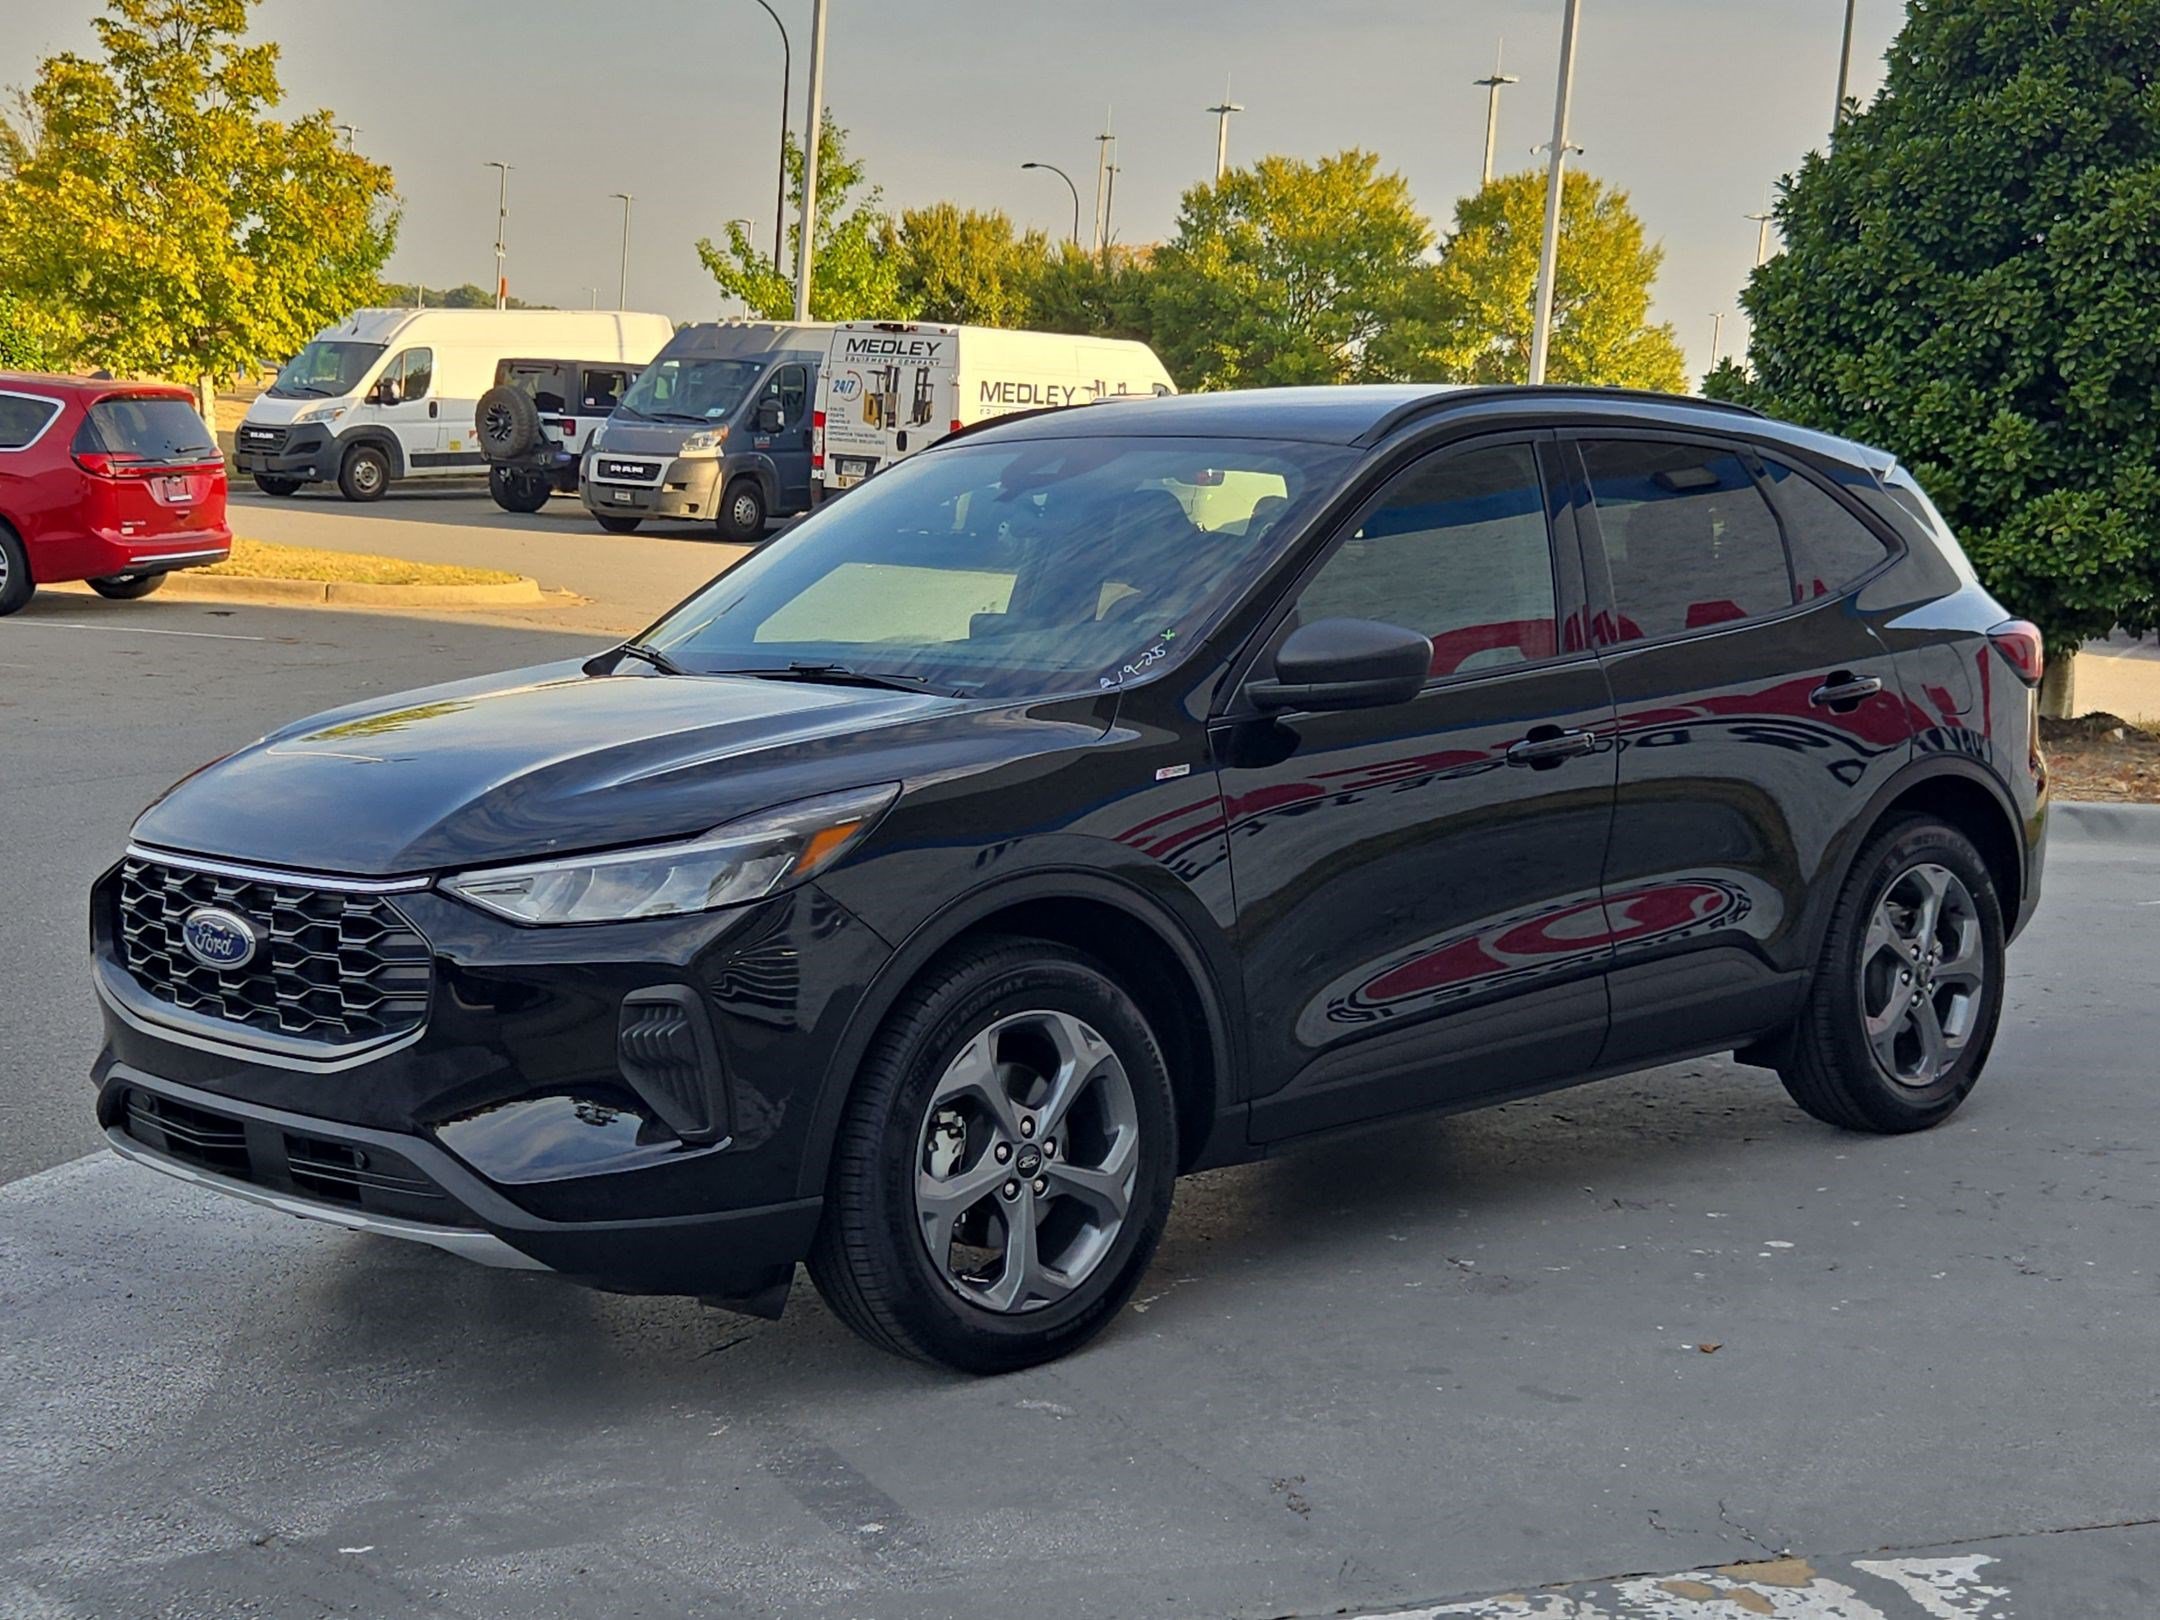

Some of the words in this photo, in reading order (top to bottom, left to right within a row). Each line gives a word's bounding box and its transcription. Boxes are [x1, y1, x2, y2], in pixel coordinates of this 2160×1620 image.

[846, 338, 942, 357] MEDLEY
[833, 379, 855, 393] 24/7
[980, 380, 1076, 407] MEDLEY
[195, 921, 234, 956] Ford
